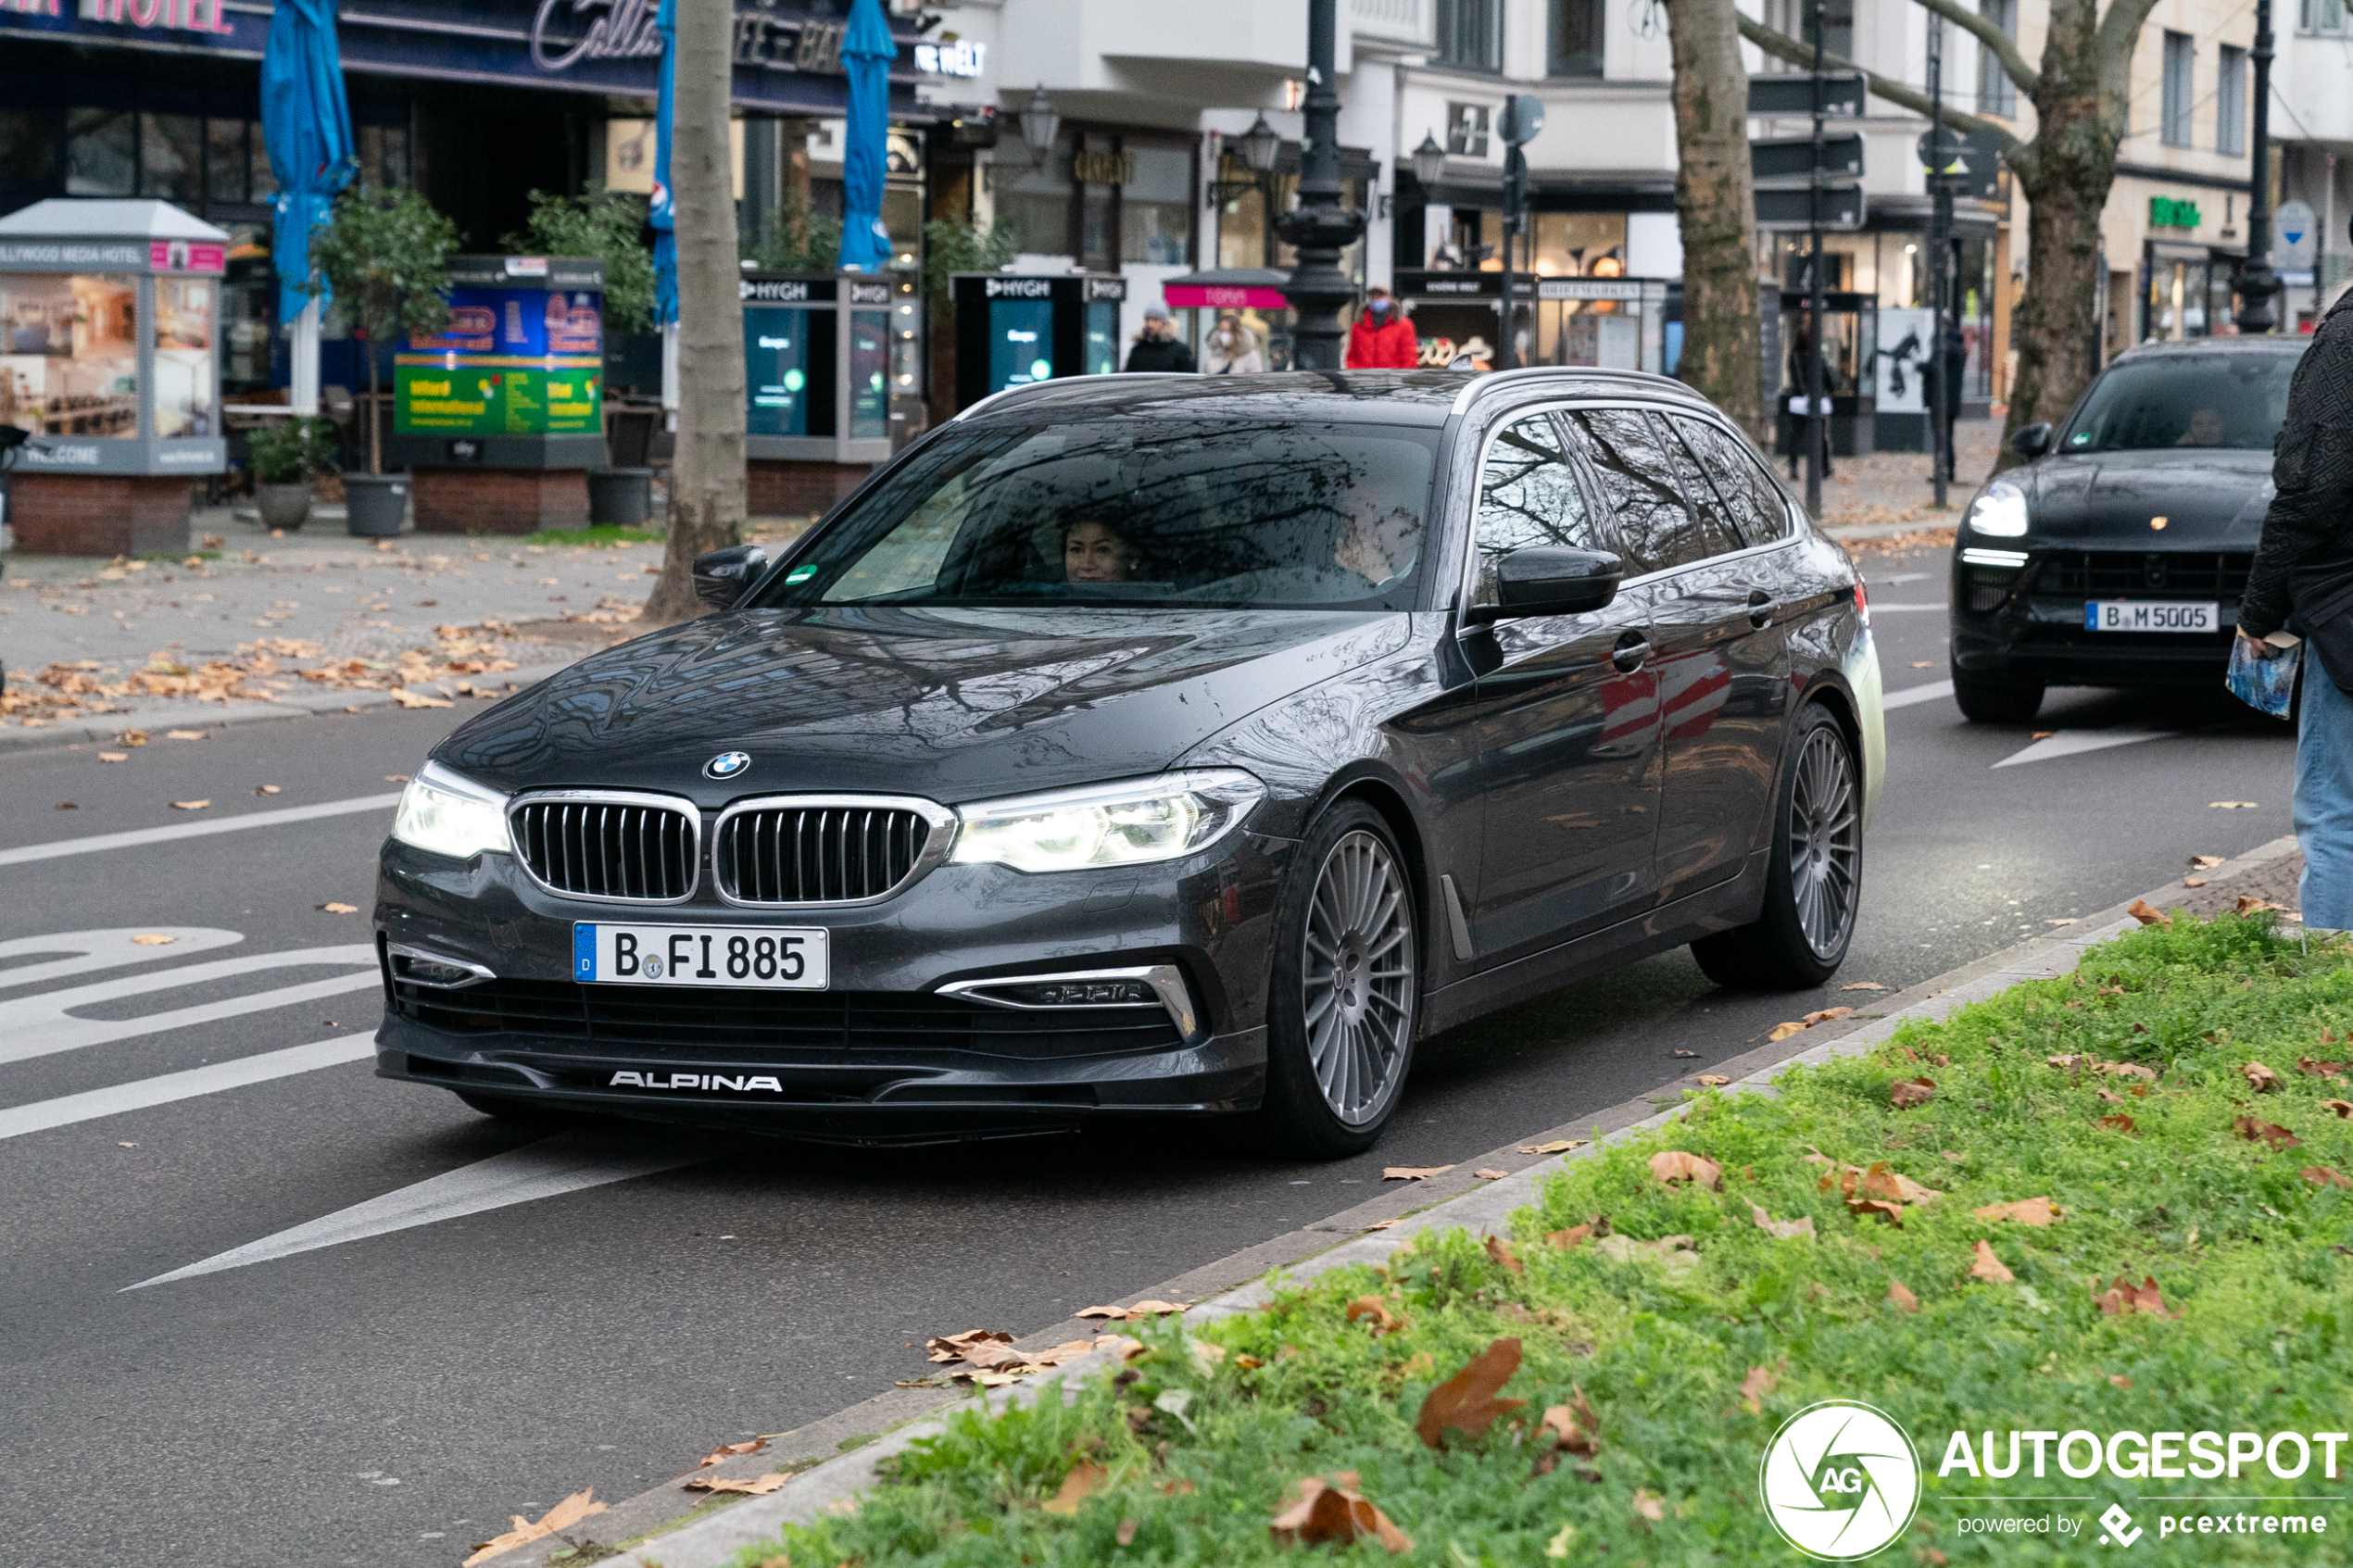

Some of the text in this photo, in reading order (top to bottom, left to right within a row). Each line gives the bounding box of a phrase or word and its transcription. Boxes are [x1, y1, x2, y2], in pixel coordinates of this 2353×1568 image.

[0, 245, 58, 262] LLYWOOD
[100, 245, 142, 264] HOTEL
[756, 281, 808, 299] HYGH
[1002, 280, 1051, 297] HYGH
[2107, 608, 2120, 626] B
[615, 932, 639, 976] B
[609, 1071, 783, 1092] ALPINA
